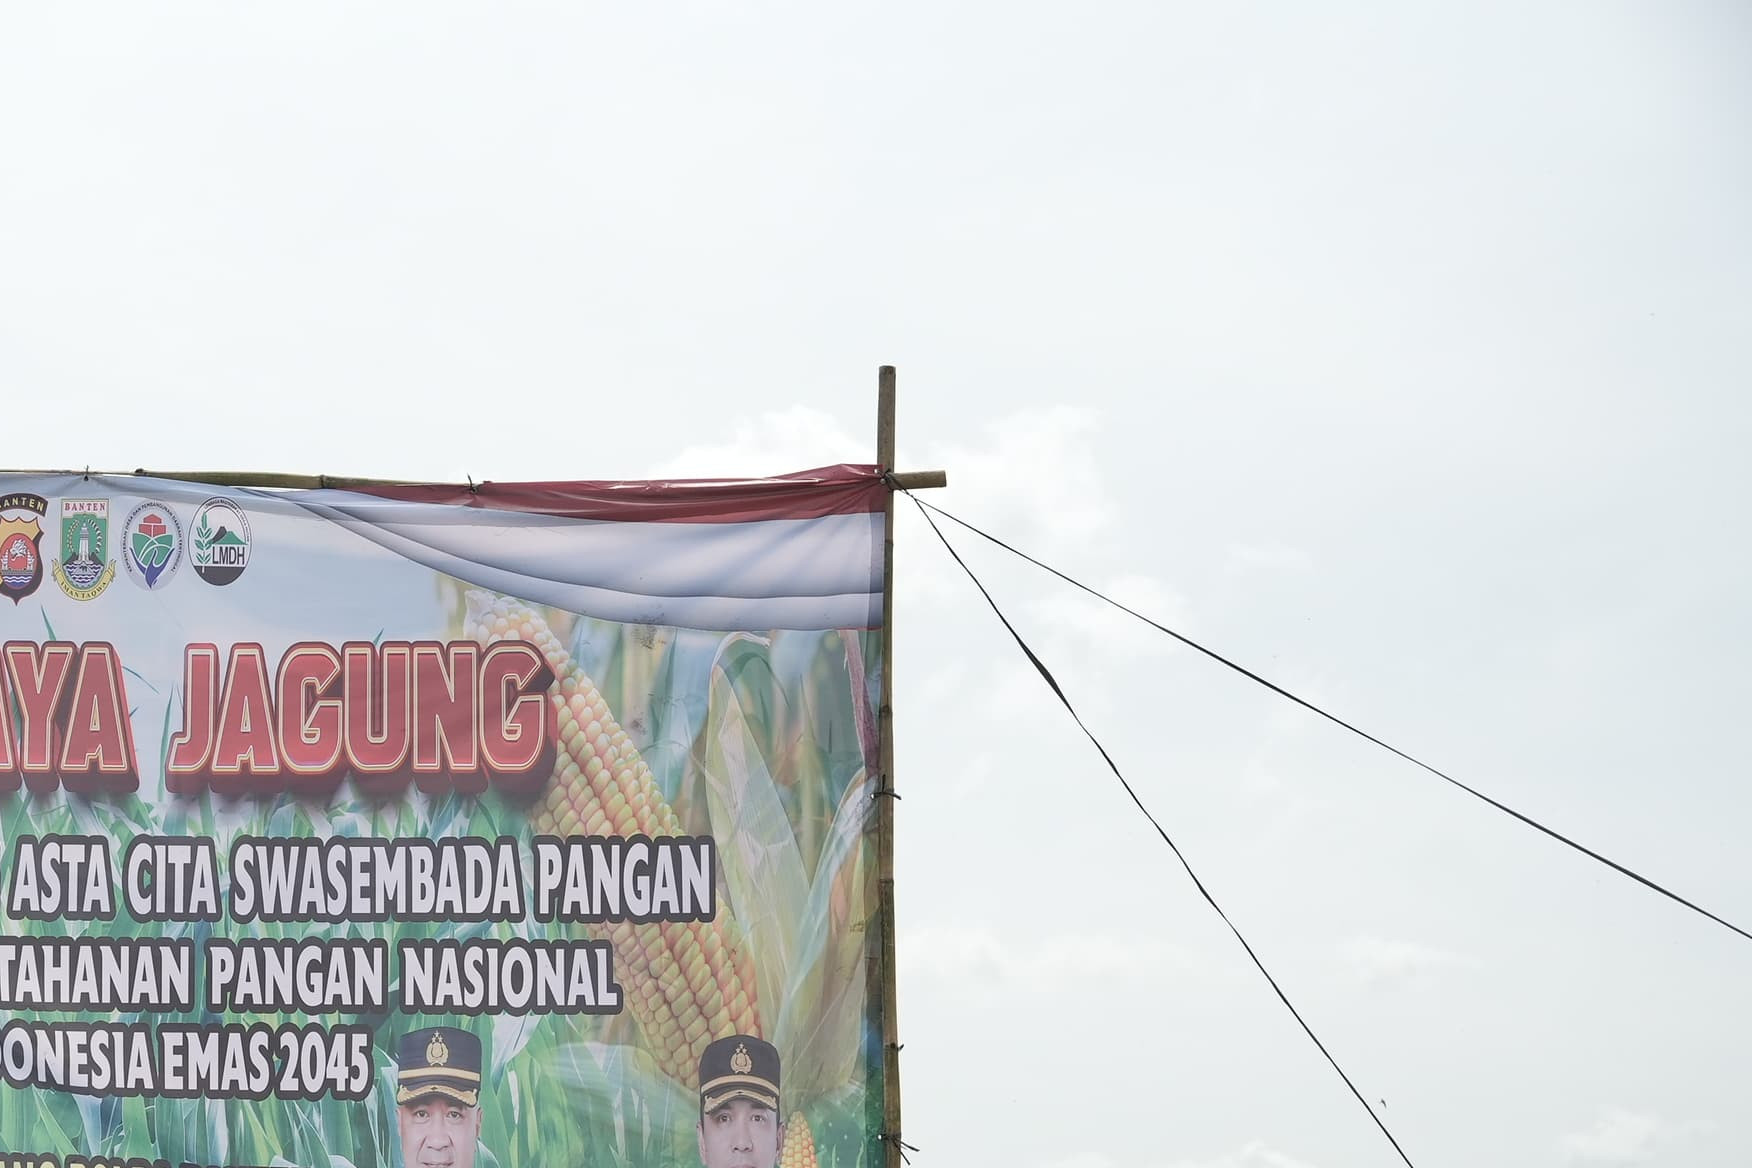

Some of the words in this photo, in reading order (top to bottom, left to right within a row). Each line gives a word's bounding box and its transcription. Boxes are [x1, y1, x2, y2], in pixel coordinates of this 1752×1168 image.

[64, 502, 106, 512] BANTEN
[212, 546, 245, 565] LMDH
[167, 641, 555, 782] JAGUNG
[13, 842, 109, 913] ASTA
[129, 842, 217, 914] CITA
[234, 842, 520, 916] SWASEMBADA
[534, 843, 710, 915] PANGAN
[211, 945, 383, 1007] PANGAN
[404, 946, 618, 1007] NASIONAL
[163, 1028, 272, 1093] EMAS
[280, 1028, 369, 1094] 2045
